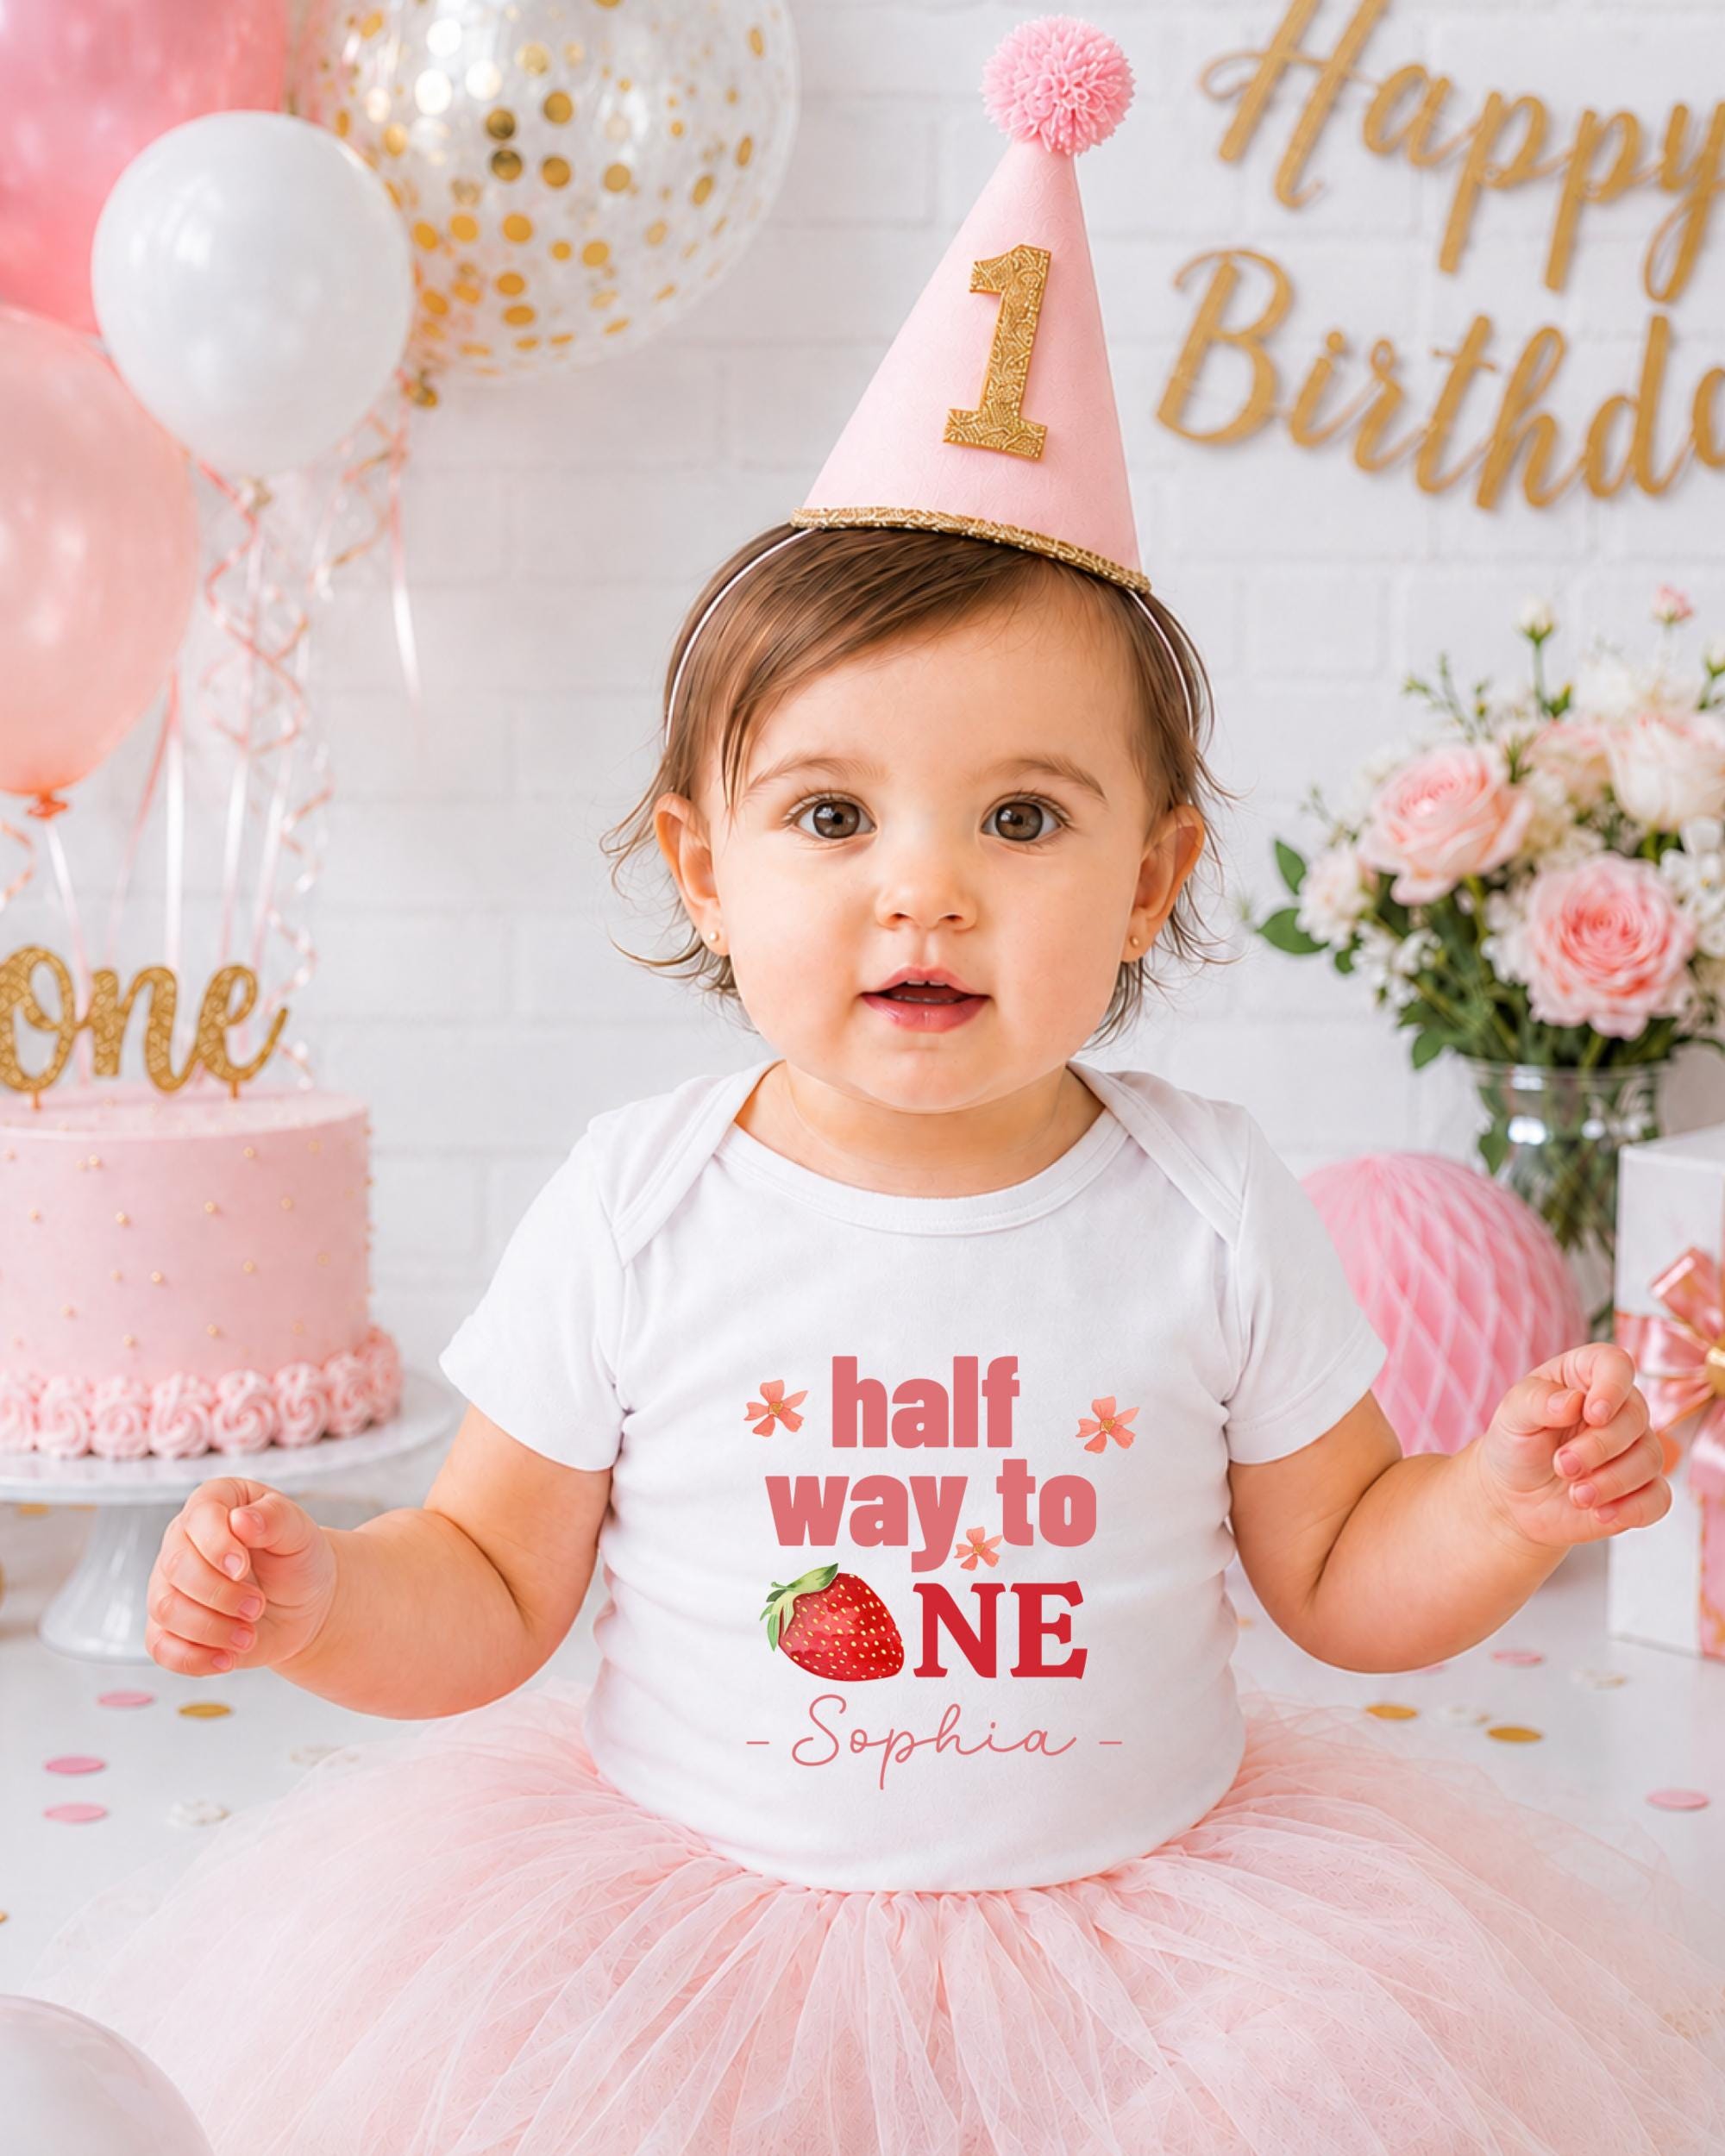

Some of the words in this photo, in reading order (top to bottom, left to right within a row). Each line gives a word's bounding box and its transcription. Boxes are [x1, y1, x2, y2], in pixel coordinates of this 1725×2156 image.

[1199, 0, 1725, 304] Happy
[944, 244, 1051, 463] 1
[831, 1355, 1020, 1449] half
[764, 1475, 969, 1573] way
[995, 1458, 1097, 1547] to
[791, 1694, 1077, 1790] Sophia
